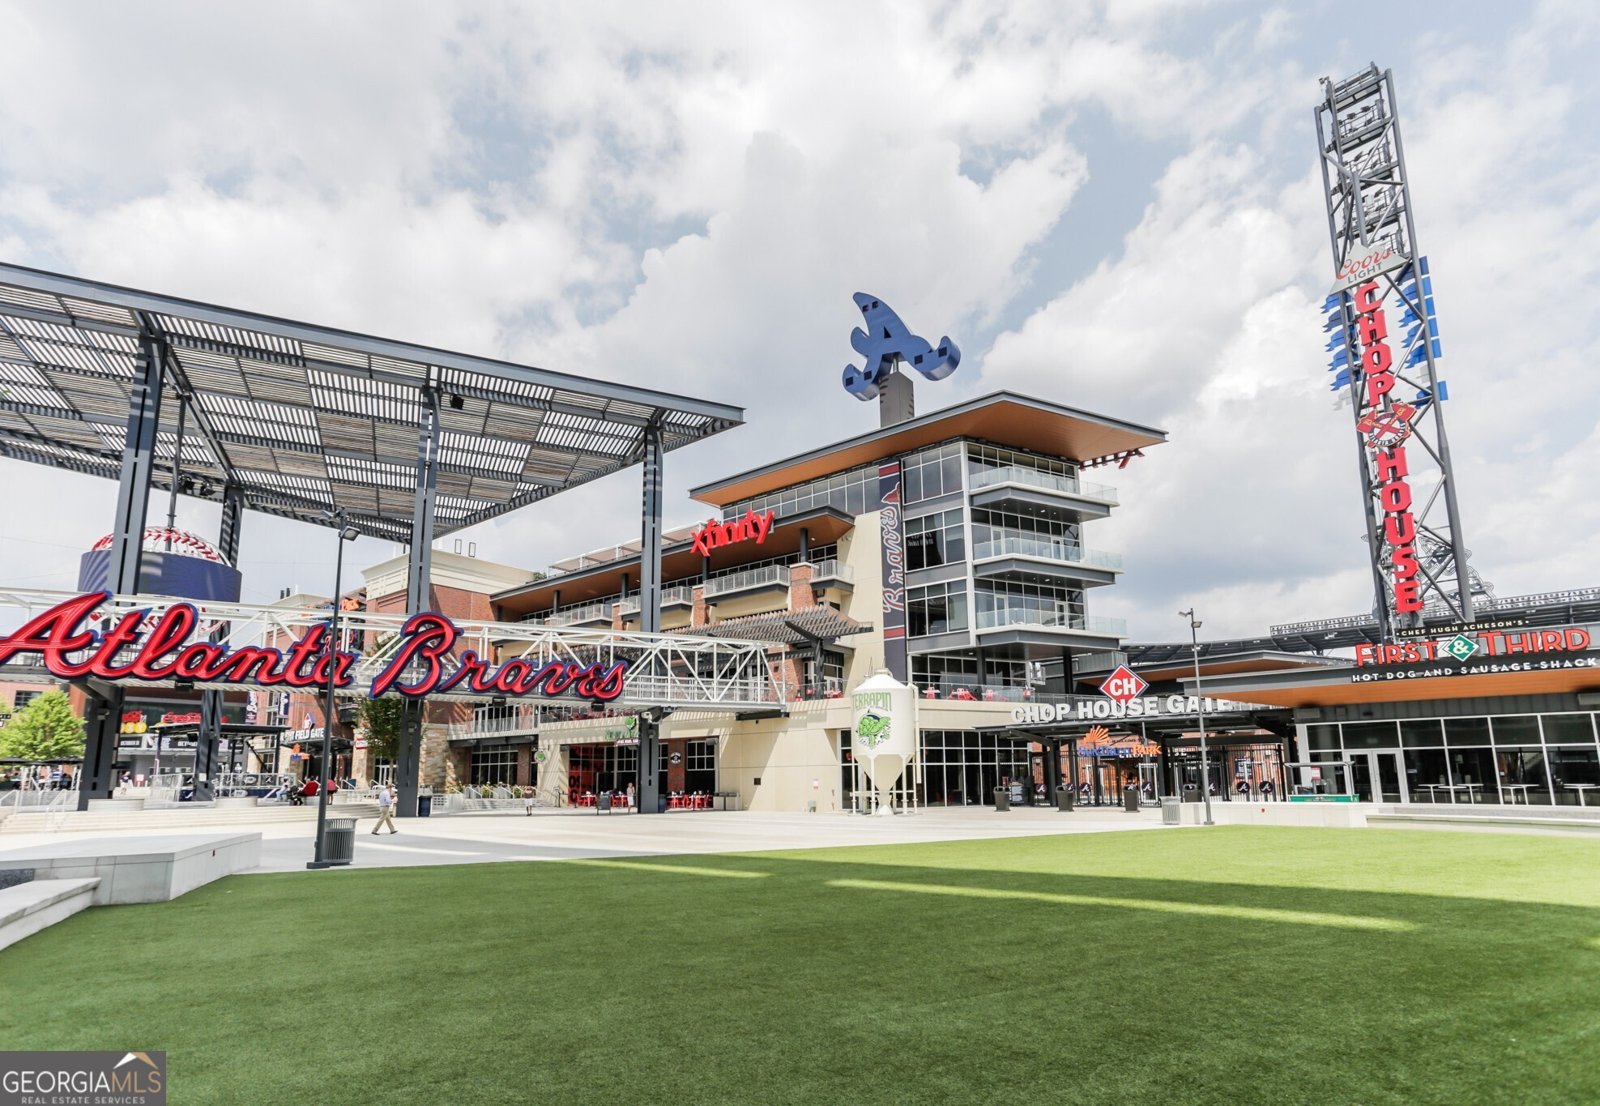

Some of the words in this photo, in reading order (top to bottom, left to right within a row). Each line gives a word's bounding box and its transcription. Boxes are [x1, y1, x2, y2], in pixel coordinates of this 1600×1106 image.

[1336, 248, 1393, 279] Coors
[1348, 262, 1383, 284] LIGHT
[1354, 281, 1396, 408] CHOP
[1376, 446, 1425, 614] HOUSE
[880, 506, 905, 613] Braves
[1401, 628, 1426, 637] CHEF
[1430, 625, 1459, 634] HUGH
[1462, 619, 1524, 631] ACHESON'S
[0, 590, 360, 689] Atlanta
[369, 611, 628, 700] Braves
[1355, 640, 1439, 668] FIRST
[1477, 628, 1591, 657] THIRD
[1352, 673, 1379, 682] HOT
[1386, 670, 1417, 680] DOG
[1423, 667, 1453, 678] AND
[1460, 661, 1532, 675] SAUSAGE
[1540, 657, 1597, 669] SHACK
[852, 692, 892, 711] TERRAPIN
[1109, 677, 1137, 697] CH
[1010, 702, 1072, 724] CHOP
[1078, 696, 1159, 719] HOUSE
[1166, 694, 1234, 715] GATE
